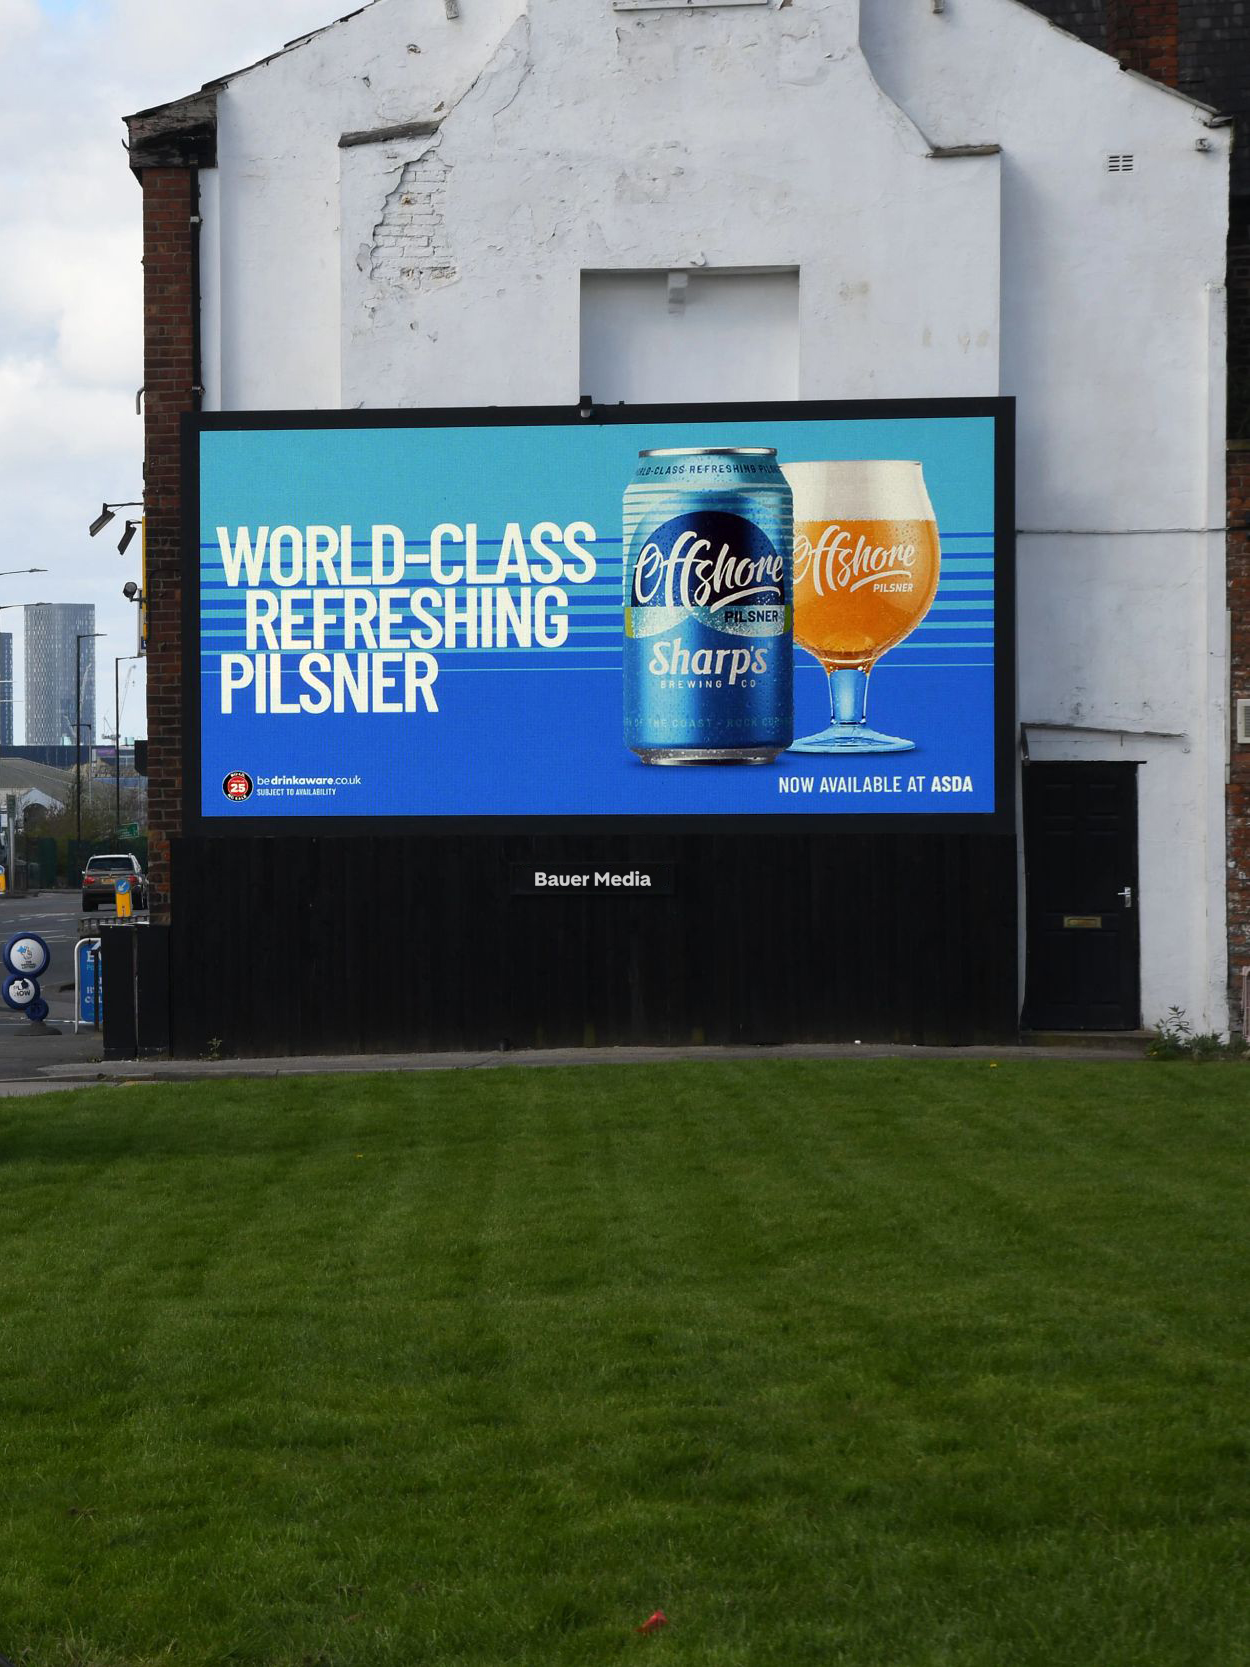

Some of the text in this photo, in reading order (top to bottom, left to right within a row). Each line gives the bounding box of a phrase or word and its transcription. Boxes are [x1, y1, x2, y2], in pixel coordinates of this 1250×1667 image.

[690, 463, 756, 474] REFRESHING
[215, 521, 597, 587] WORLD-CLASS
[793, 524, 916, 597] Offshore
[633, 530, 784, 610] Offshore
[872, 582, 914, 593] PILSNER
[245, 586, 569, 651] REFRESHING
[724, 609, 779, 623] PILSNER
[648, 637, 768, 685] Sharp's
[220, 652, 440, 714] PILSNER
[660, 679, 756, 689] BREWING CO
[230, 783, 246, 793] 25
[256, 788, 337, 797] SUBJECT TO AVAILABILITY
[778, 775, 974, 793] NOW AVAILABLE AT ASDA
[534, 870, 652, 887] Bauer Media
